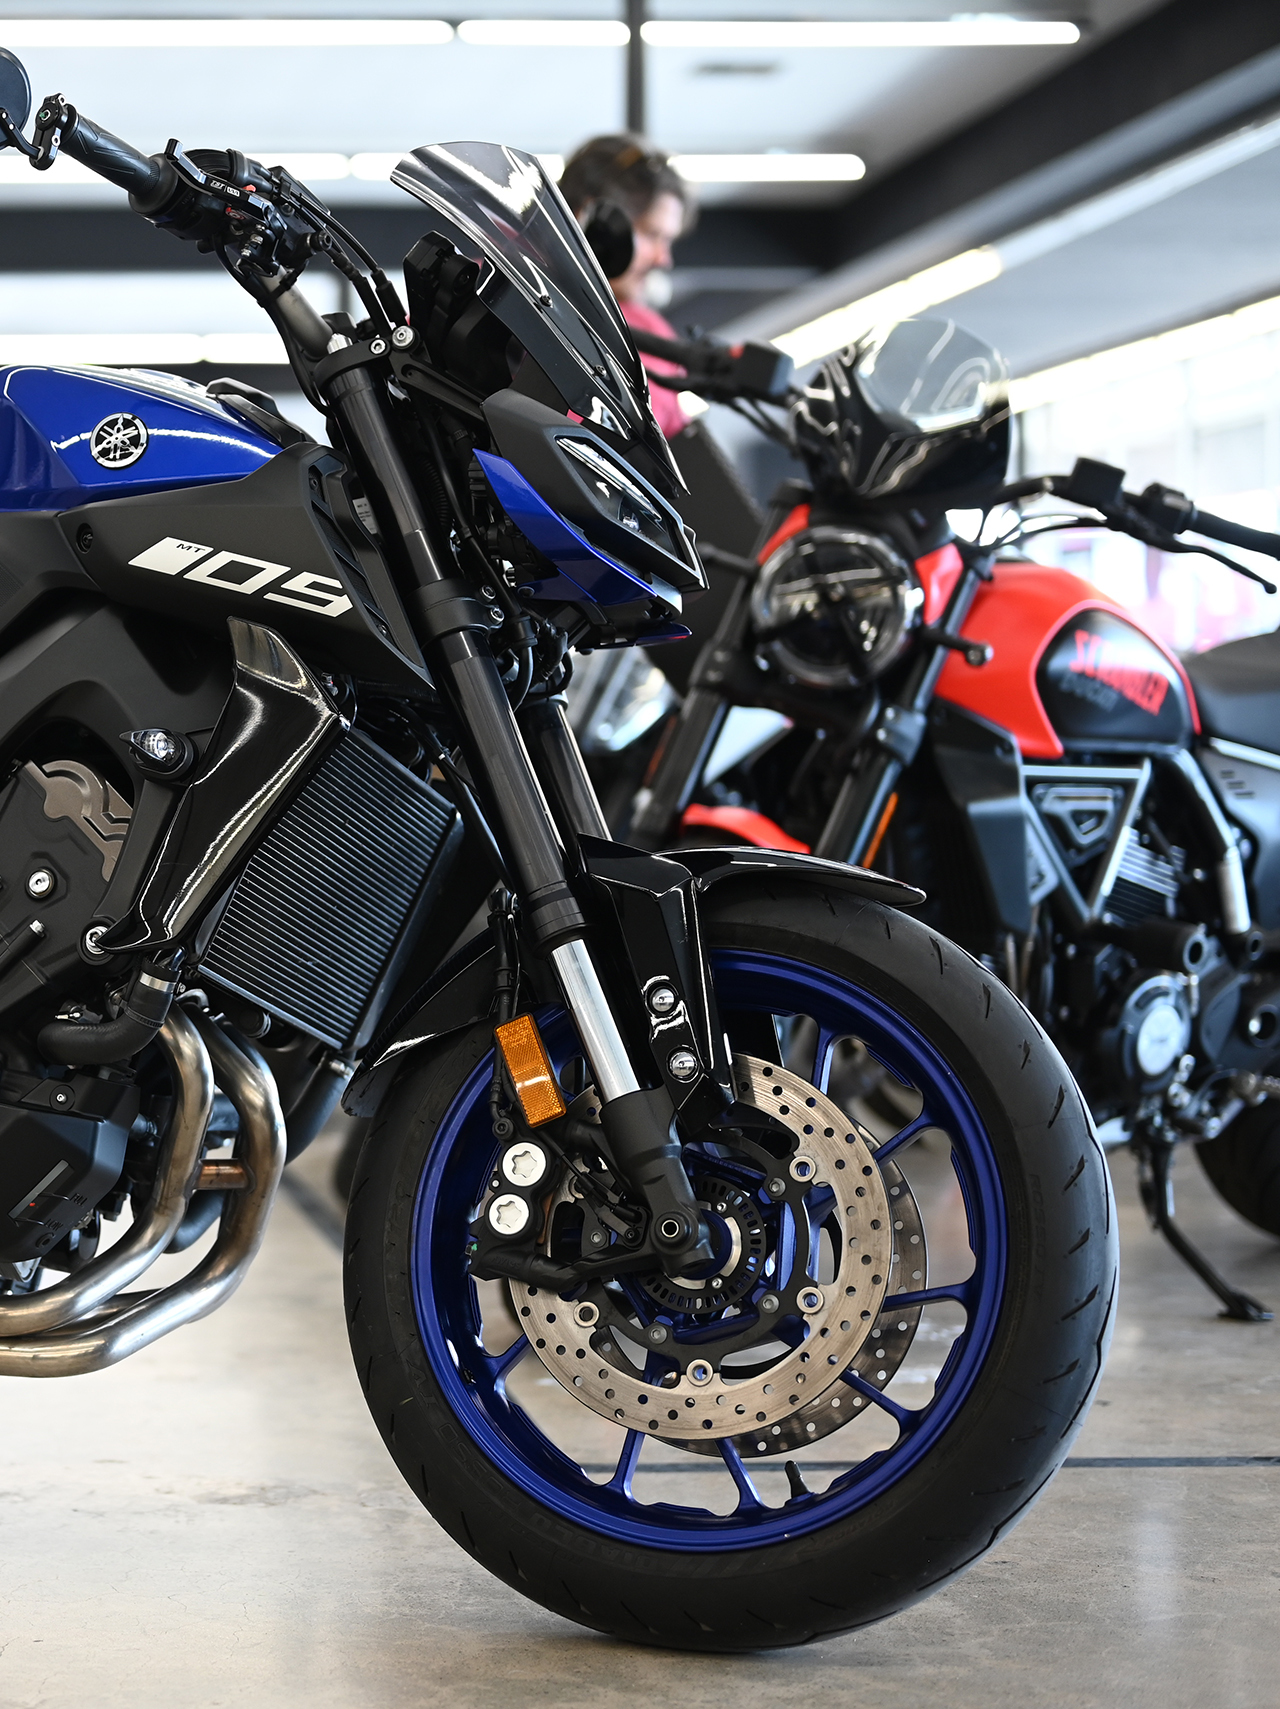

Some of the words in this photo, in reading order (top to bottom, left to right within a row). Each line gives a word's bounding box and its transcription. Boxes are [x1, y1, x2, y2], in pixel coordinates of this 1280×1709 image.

[176, 543, 206, 553] MT
[70, 1193, 88, 1206] FULL
[45, 1218, 64, 1231] LOW
[436, 1421, 523, 1514] ROSSO
[529, 1510, 656, 1571] DIABLO
